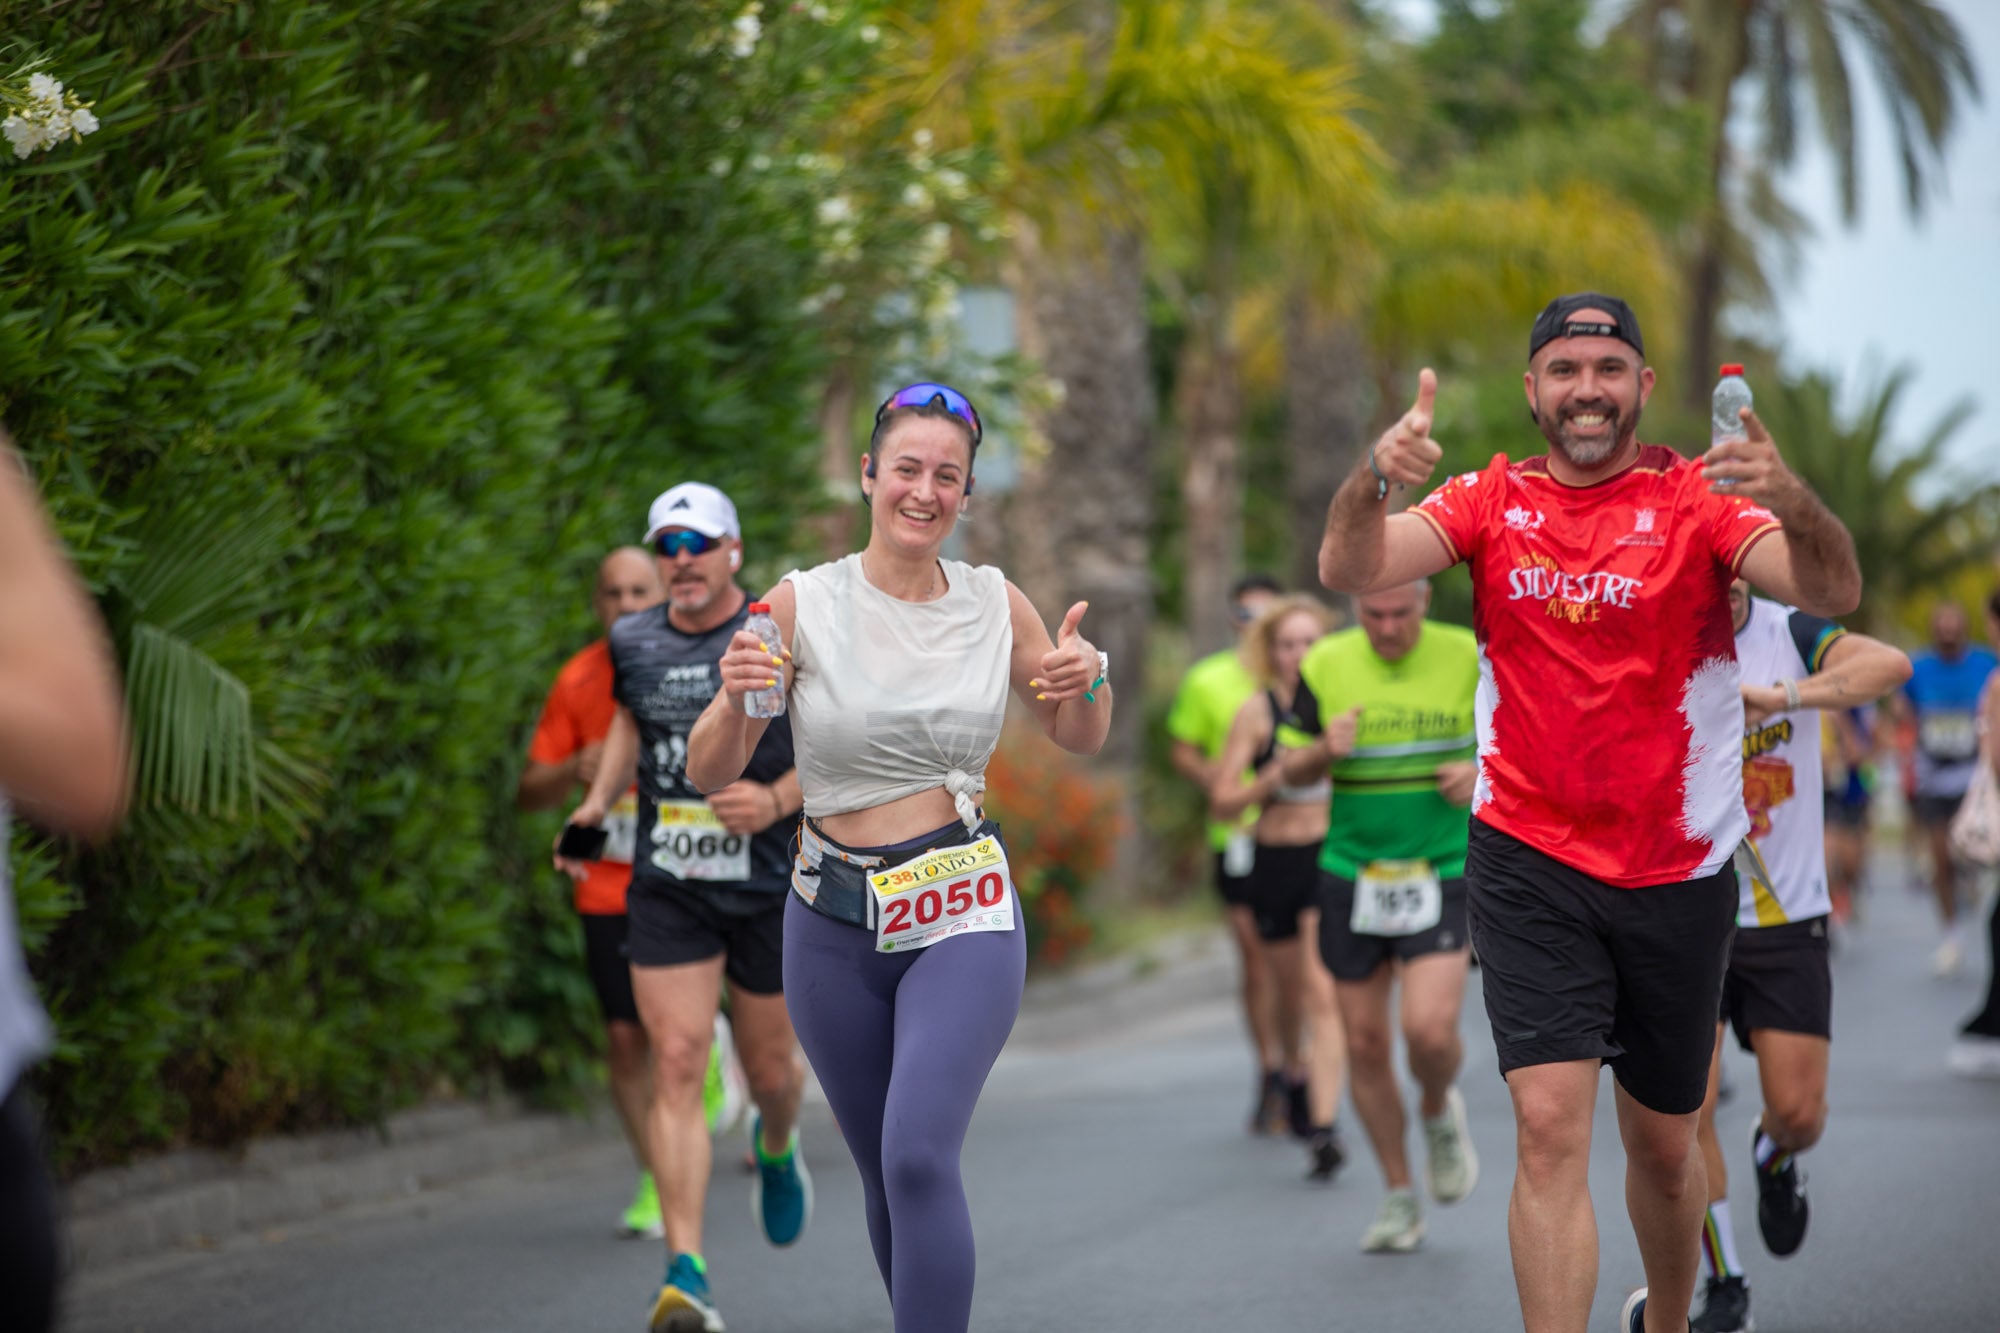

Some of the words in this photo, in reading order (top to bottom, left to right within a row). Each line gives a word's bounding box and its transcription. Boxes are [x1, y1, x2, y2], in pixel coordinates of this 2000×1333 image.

[1508, 567, 1643, 609] SILVESTRE
[1545, 597, 1601, 624] ATARFE
[913, 857, 976, 881] FONDO
[914, 856, 938, 870] GRAN
[938, 850, 965, 861] PREMIO
[890, 870, 914, 885] 38
[882, 872, 1004, 935] 2050
